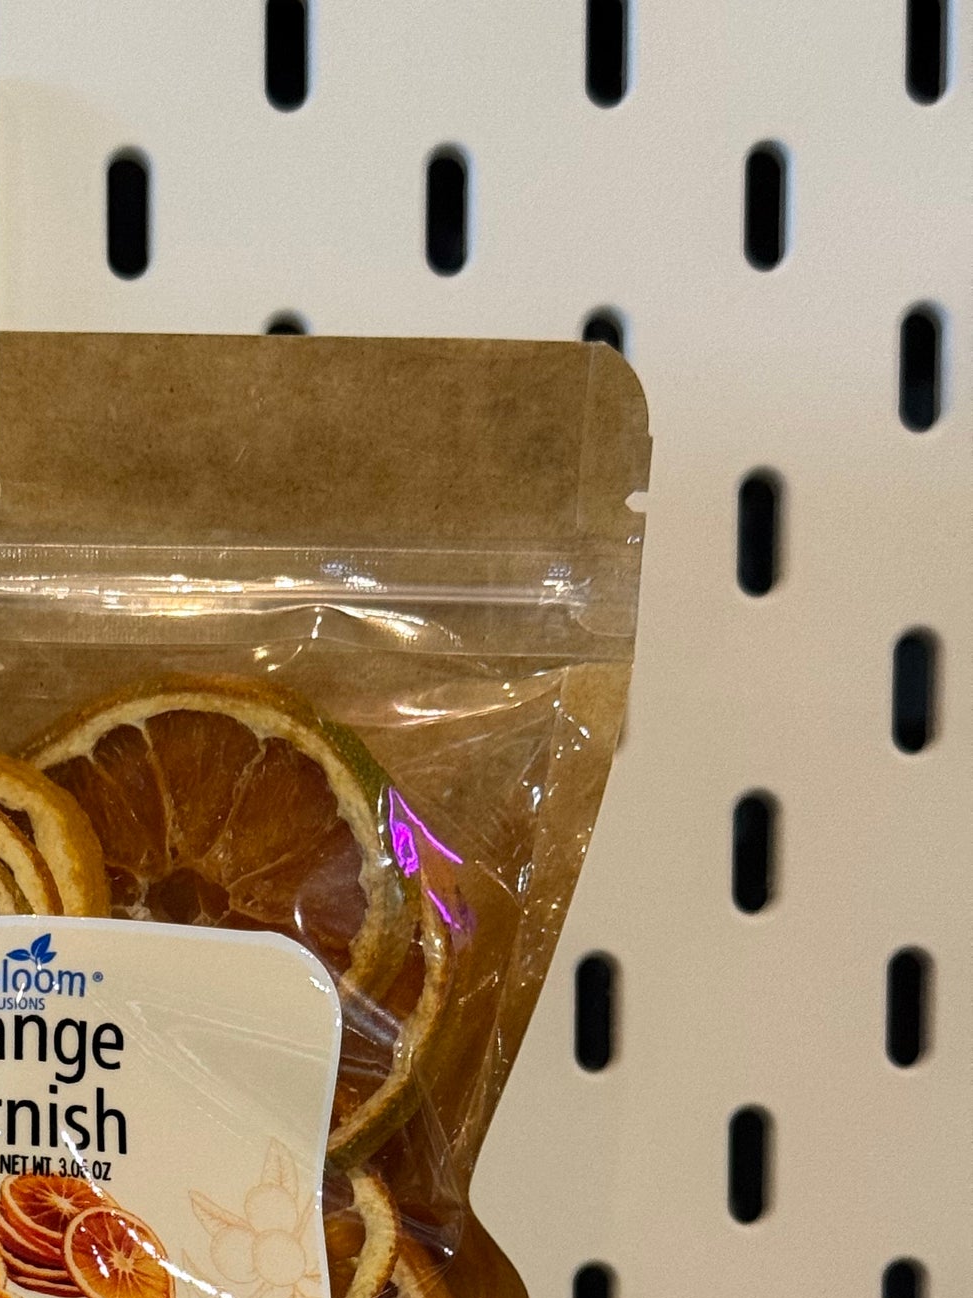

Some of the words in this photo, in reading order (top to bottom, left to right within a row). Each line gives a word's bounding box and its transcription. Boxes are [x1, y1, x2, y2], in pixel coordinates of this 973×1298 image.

[0, 1155, 29, 1176] NET
[32, 1156, 55, 1178] WT.
[92, 1160, 112, 1182] OZ
